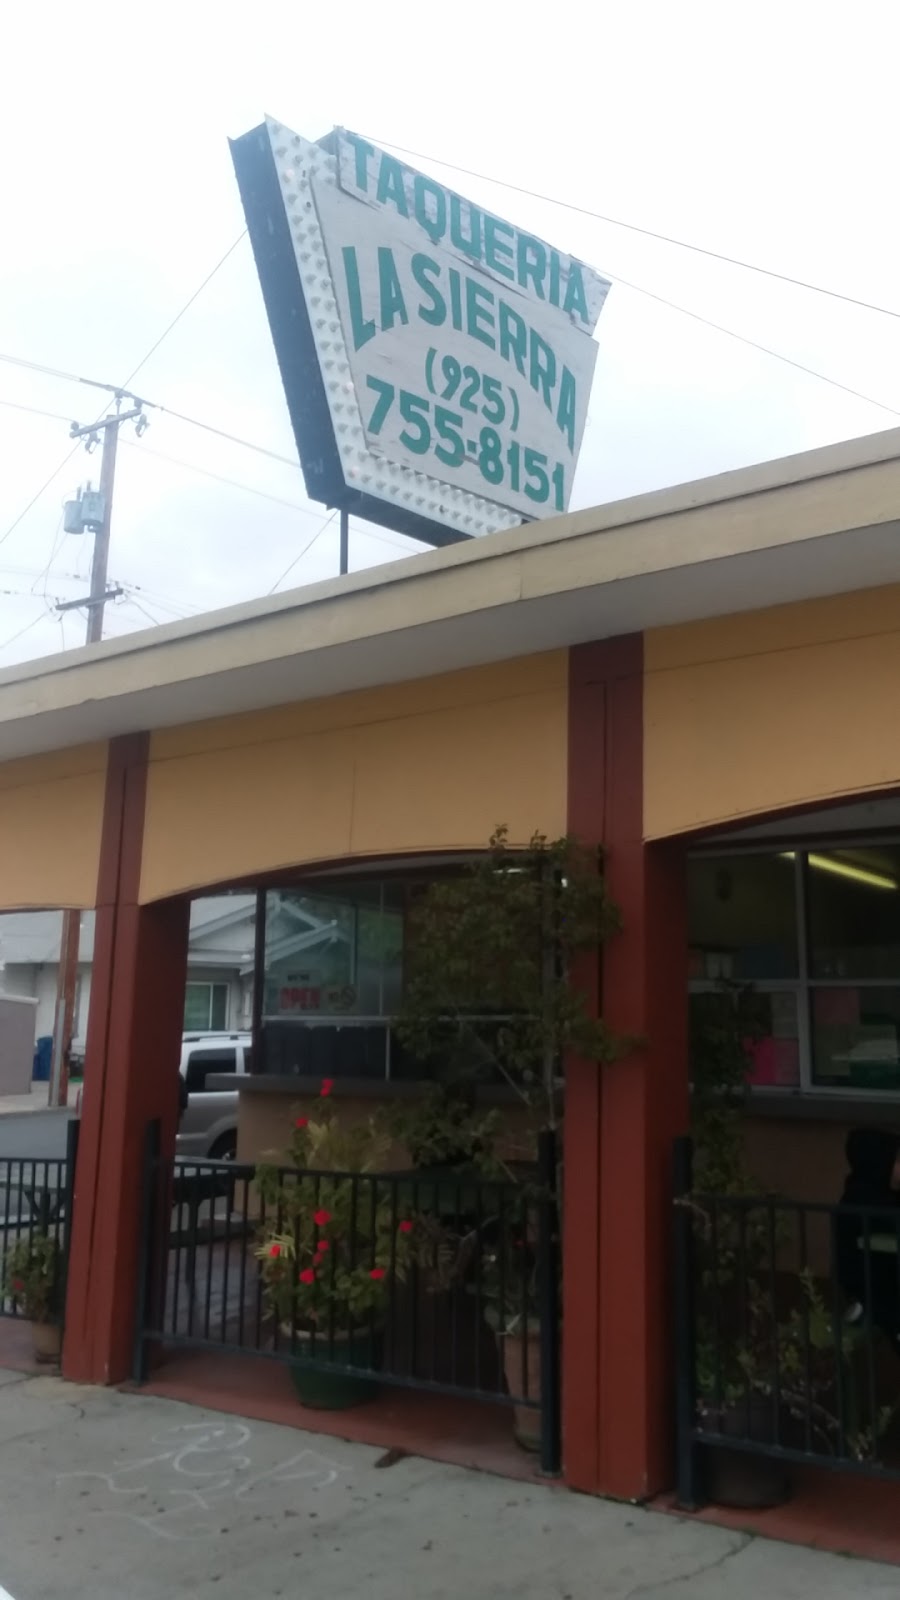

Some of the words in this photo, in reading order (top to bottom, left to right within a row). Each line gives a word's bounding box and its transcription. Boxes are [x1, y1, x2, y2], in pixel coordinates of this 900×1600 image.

[347, 137, 592, 325] TAQUERIA
[342, 246, 409, 352] LA
[411, 253, 576, 455] SIERRA
[425, 347, 520, 431] (925)
[366, 374, 565, 512] 755-8151
